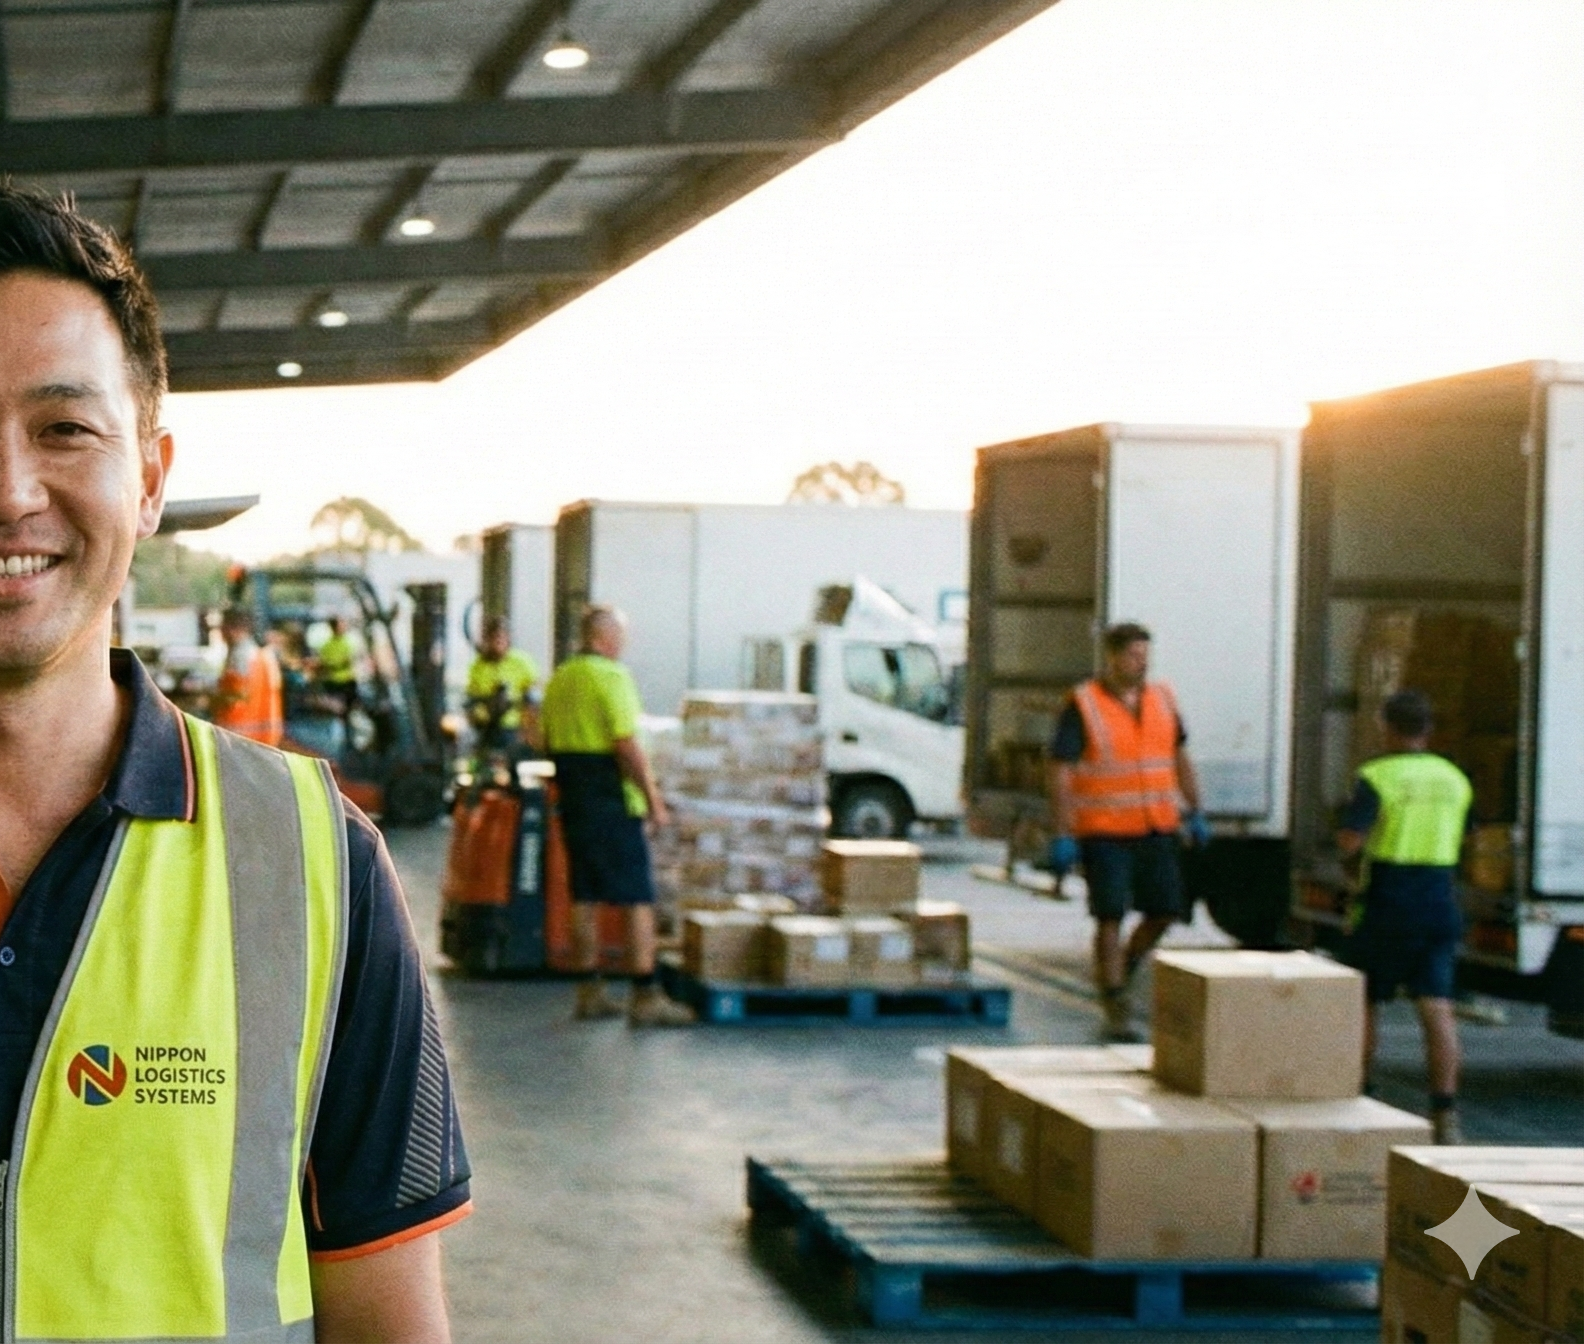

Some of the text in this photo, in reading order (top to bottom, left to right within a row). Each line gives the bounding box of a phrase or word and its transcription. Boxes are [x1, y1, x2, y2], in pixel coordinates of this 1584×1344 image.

[135, 1046, 206, 1062] NIPPON
[135, 1067, 226, 1084] LOGISTICS
[134, 1088, 216, 1105] SYSTEMS
